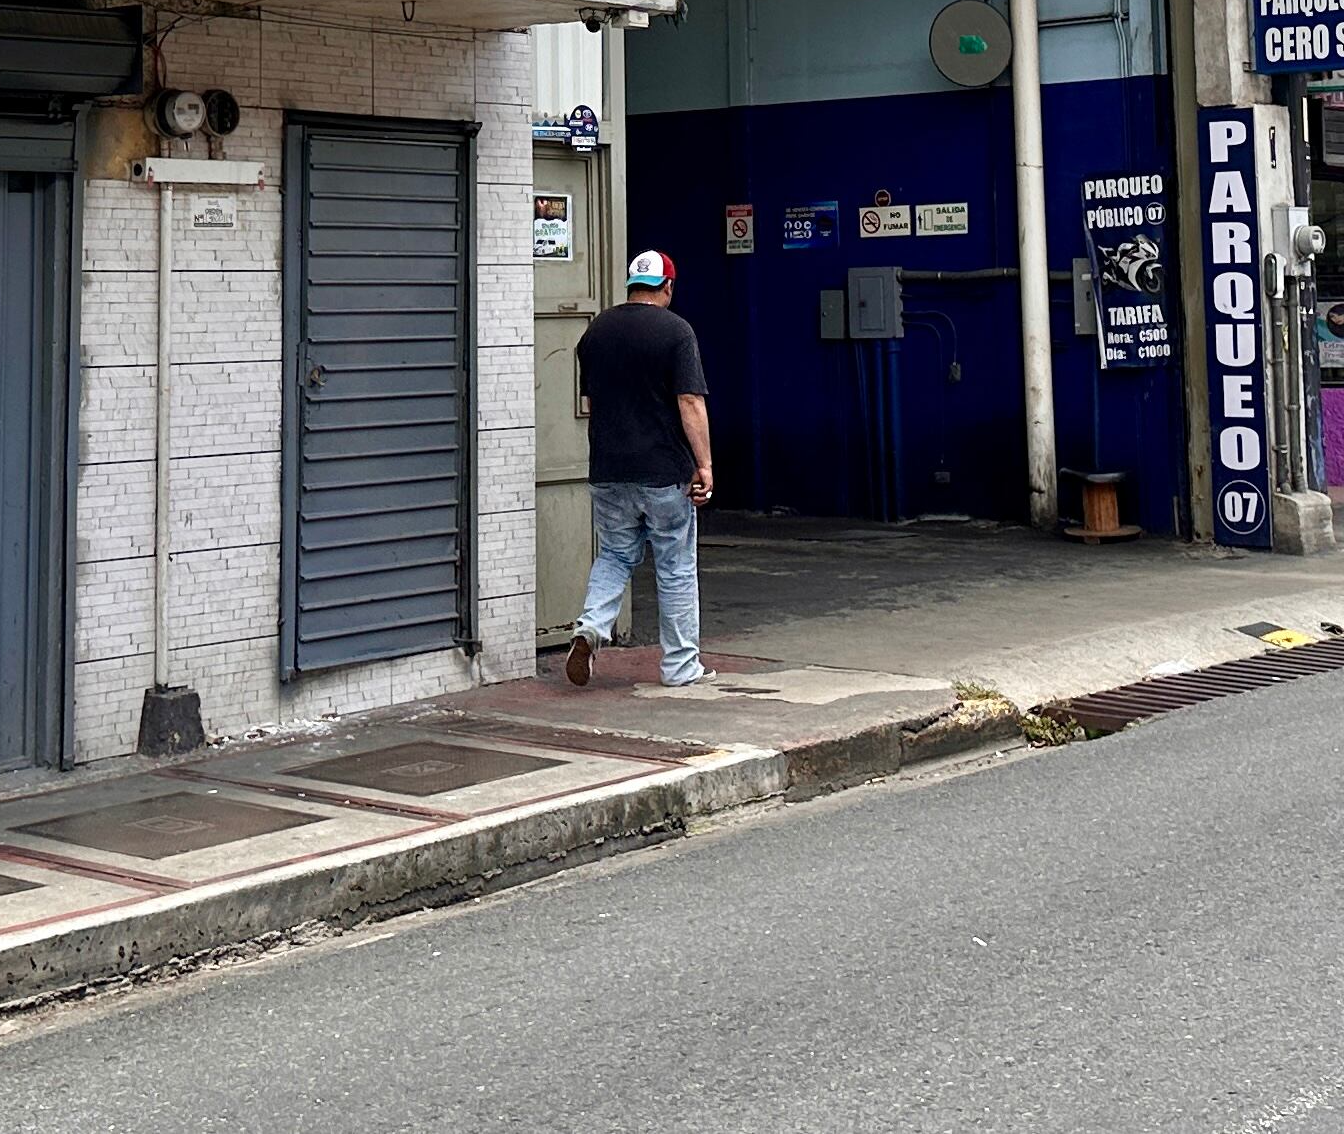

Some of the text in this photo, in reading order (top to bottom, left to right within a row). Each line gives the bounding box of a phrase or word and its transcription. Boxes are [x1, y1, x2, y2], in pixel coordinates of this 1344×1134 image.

[1265, 24, 1329, 63] CERO
[1084, 174, 1163, 199] PARQUEO
[936, 206, 966, 215] SALIDA
[1086, 205, 1163, 229] PÚBLICO 07
[883, 222, 909, 231] FUMAR
[1209, 120, 1261, 472] PARQUEO
[1108, 304, 1164, 326] TARIFA
[1108, 331, 1134, 344] Hora:
[1224, 491, 1258, 524] 07
